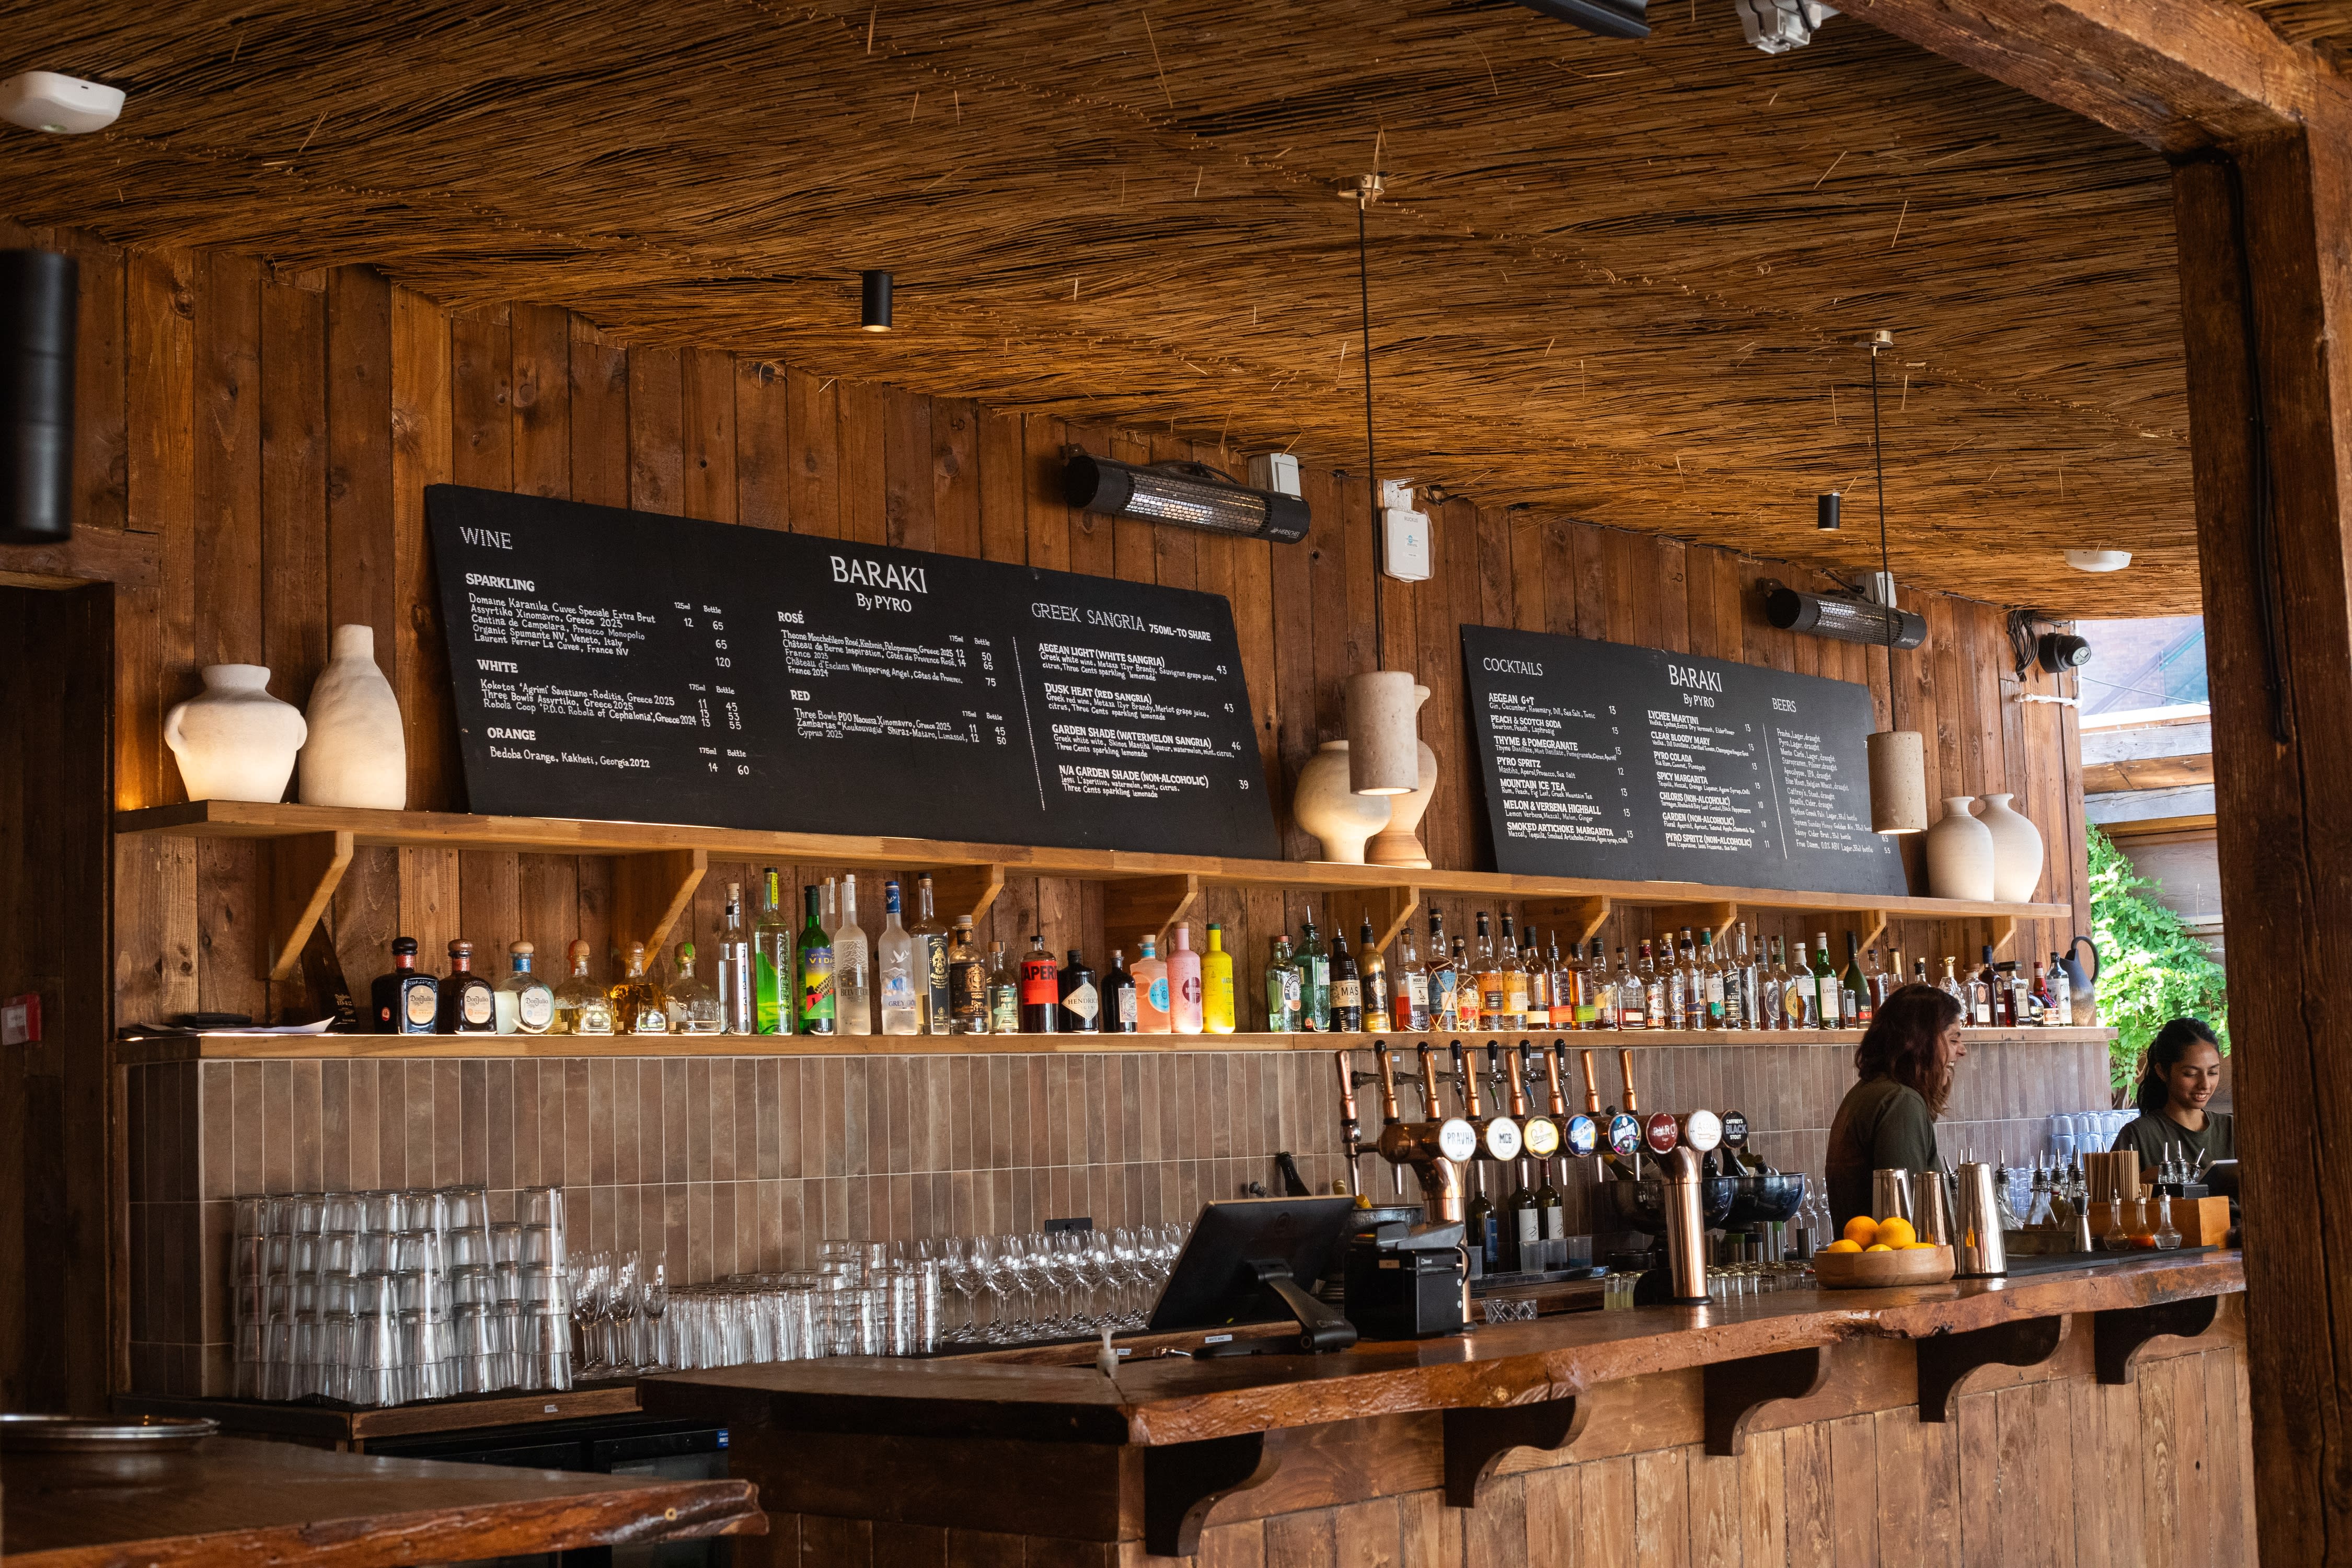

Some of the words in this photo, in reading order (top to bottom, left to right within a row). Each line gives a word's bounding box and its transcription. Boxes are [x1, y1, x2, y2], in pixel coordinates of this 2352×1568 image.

[459, 526, 512, 549] WINE
[1278, 528, 1300, 537] HERSCHEL
[829, 556, 928, 593] BARAKI
[465, 573, 535, 592] SPARKLING
[468, 592, 506, 606] Domaine
[508, 597, 549, 611] Karanika
[552, 602, 577, 614] Cuvee
[578, 605, 609, 617] Speciale
[612, 609, 635, 620] Extra
[637, 612, 655, 623] Brut
[703, 605, 721, 614] Bottle
[856, 593, 872, 610] By
[874, 595, 912, 612] PYRO
[684, 617, 694, 627] 12
[712, 620, 723, 630] 65
[777, 610, 804, 624] ROSÉ
[1031, 603, 1081, 622] GREEK
[1087, 609, 1145, 631] SANGRIA
[1187, 629, 1211, 641] SHARE
[474, 632, 508, 643] Laurent
[511, 637, 540, 647] Perrier
[543, 639, 554, 648] La
[557, 641, 583, 652] Cuvee,
[586, 644, 614, 654] France
[616, 647, 629, 656] NV
[715, 639, 727, 649] 65
[715, 656, 731, 667] 120
[955, 649, 965, 658] 12
[982, 652, 991, 662] 50
[1039, 643, 1070, 654] AEGEAN
[1070, 647, 1094, 658] LIGHT
[1095, 649, 1126, 662] (WHITE
[1127, 654, 1165, 668] SANGRIA)
[476, 659, 518, 673] WHITE
[1216, 665, 1227, 675] 43
[1483, 657, 1543, 676] COCKTAILS
[985, 677, 996, 687] 75
[1668, 664, 1722, 692] BARAKI
[716, 685, 735, 695] Bottle
[790, 689, 810, 701] RED
[1044, 683, 1069, 694] DUSK
[1070, 686, 1093, 697] HEAT
[1094, 688, 1113, 699] (RED
[1114, 692, 1152, 705] SANGRIA)
[698, 698, 707, 709] 11
[725, 702, 737, 712] 45
[1489, 693, 1518, 704] AEGEAN
[1520, 696, 1535, 706] G+T
[1683, 693, 1692, 707] By
[1693, 695, 1714, 708] PYRO
[1771, 697, 1796, 712] BEERS
[1224, 703, 1233, 712] 43
[1608, 705, 1616, 714] 13
[1490, 714, 1513, 724] PEACH
[1513, 716, 1519, 724] &
[1519, 717, 1544, 727] SCOTCH
[1545, 719, 1562, 729] SODA
[1647, 710, 1670, 721] LYCHEE
[1670, 713, 1699, 724] MARTINI
[487, 727, 536, 741] ORANGE
[1745, 723, 1751, 732] 13
[1052, 724, 1087, 736] GARDEN
[1088, 727, 1116, 739] SHADE
[1116, 729, 1173, 744] (WATERMELON
[1175, 736, 1212, 749] SANGRIA)
[1493, 735, 1520, 746] THYME
[1521, 737, 1527, 746] &
[1527, 737, 1578, 751] POMEGRANATE
[1651, 731, 1670, 741] CLEAR
[1670, 733, 1692, 743] BLOODY
[1693, 736, 1710, 746] MARY
[1231, 741, 1241, 750] 46
[1615, 746, 1621, 755] 13
[1496, 756, 1516, 766] PYRO
[1517, 758, 1541, 768] SPRITZ
[1653, 751, 1669, 760] PYRO
[1669, 752, 1693, 763] COLADA
[708, 762, 718, 772] 14
[737, 765, 749, 775] 60
[1058, 765, 1075, 776] N/A
[1075, 766, 1110, 778] GARDEN
[1111, 769, 1140, 780] SHADE
[1140, 771, 1208, 788] (NON-ALCOHOLIC)
[1656, 771, 1673, 781] SPICY
[1674, 773, 1708, 785] MARGARITA
[1238, 779, 1249, 789] 39
[1500, 778, 1537, 790] MOUNTAIN
[1538, 780, 1550, 790] ICE
[1550, 781, 1566, 791] TEA
[1620, 788, 1628, 797] 13
[1659, 791, 1684, 801] CHLORIS
[1684, 793, 1730, 807] (NON-ALCOHOLIC)
[1503, 799, 1529, 810] MELON
[1530, 801, 1536, 811] &
[1535, 801, 1567, 812] VERBENA
[1567, 803, 1601, 815] HIGHBALL
[1623, 808, 1630, 817] 13
[1662, 812, 1686, 822] GARDEN
[1687, 813, 1735, 827] (NON-ALCOHOLIC)
[1506, 822, 1537, 832] SMOKED
[1538, 823, 1574, 833] ARTICHOKE
[1575, 826, 1614, 836] MARGARITA
[1627, 830, 1633, 838] 13
[1665, 833, 1682, 842] PYRO
[1682, 834, 1703, 843] SPRITZ
[1703, 834, 1752, 848] (NON-ALCOHOLIC)
[1653, 1124, 1676, 1136] PYRO
[1725, 1124, 1747, 1134] BLACK
[1447, 1132, 1474, 1145] PRAVHA
[1498, 1133, 1512, 1144] MCB
